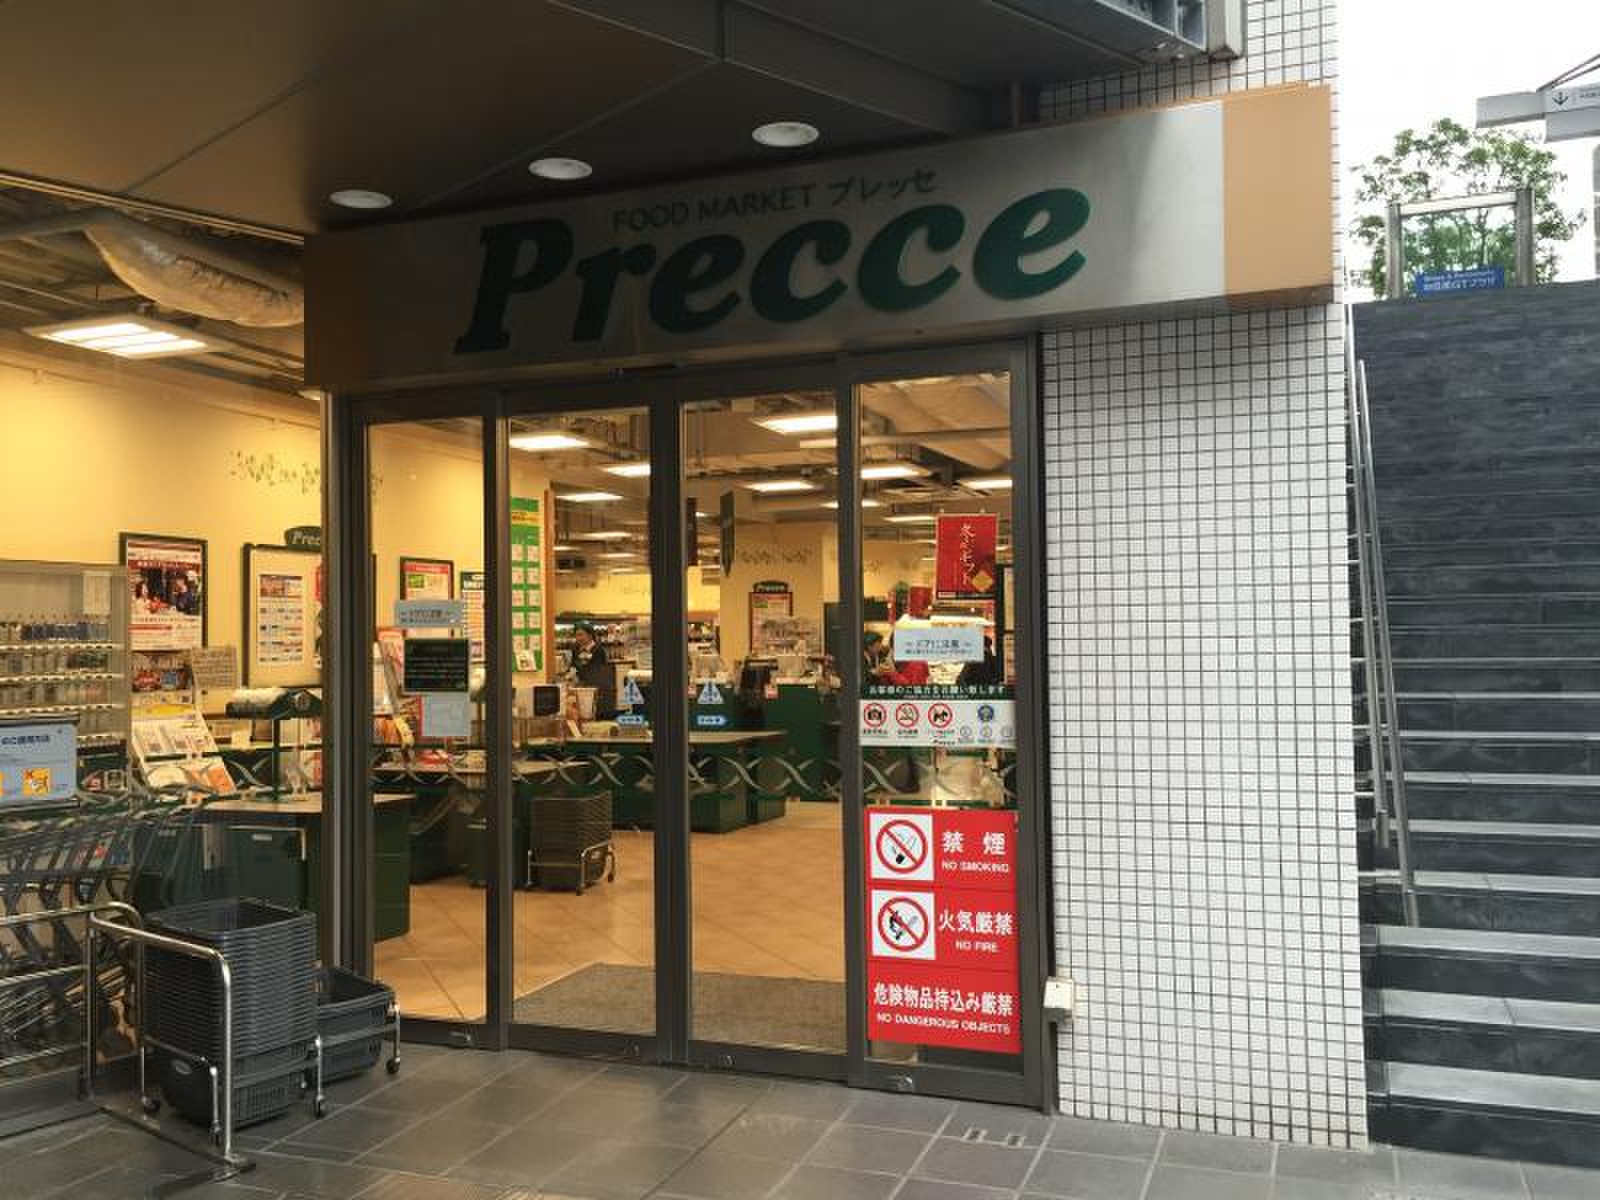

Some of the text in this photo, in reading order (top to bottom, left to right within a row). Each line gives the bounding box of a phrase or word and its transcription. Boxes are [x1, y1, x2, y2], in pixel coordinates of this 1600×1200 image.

[613, 204, 689, 233] FOOD
[700, 186, 816, 221] MARKET
[453, 187, 1092, 354] Precce
[941, 861, 1009, 873] NO SMOKING
[939, 909, 1015, 936] 火気厳禁
[956, 940, 998, 952] NO FIRE
[873, 982, 1014, 1017] 危険物品持込み厳禁
[877, 1012, 1010, 1034] NO DANGEROUS OBJECTS
